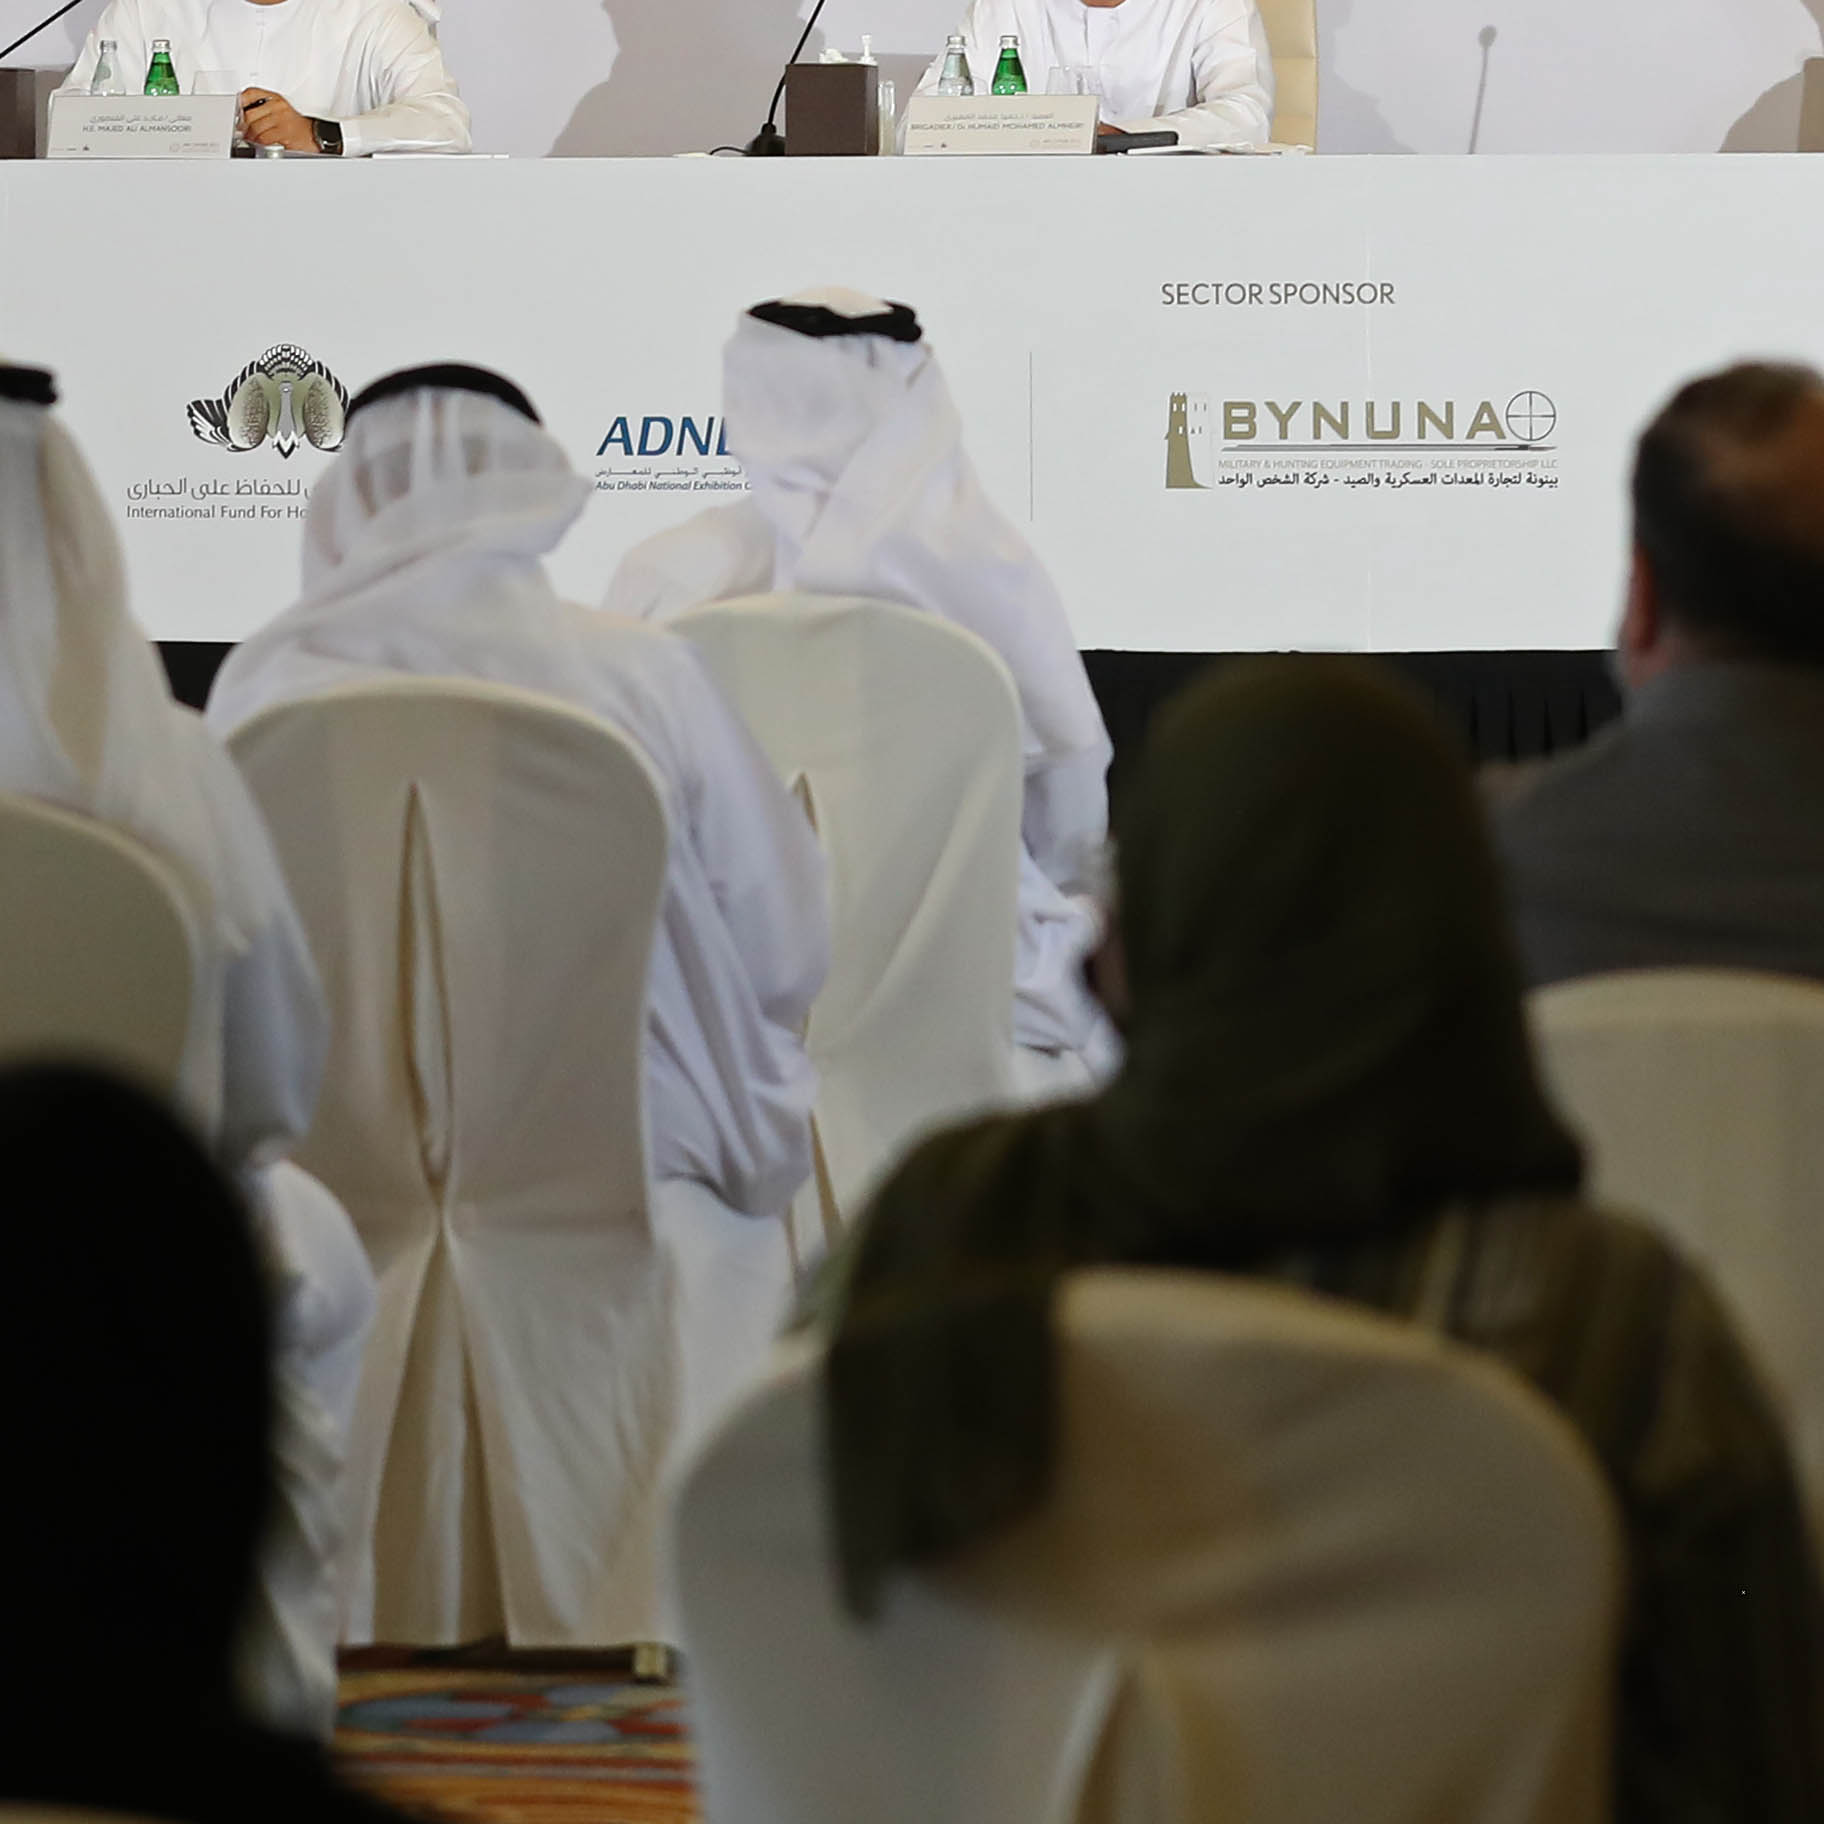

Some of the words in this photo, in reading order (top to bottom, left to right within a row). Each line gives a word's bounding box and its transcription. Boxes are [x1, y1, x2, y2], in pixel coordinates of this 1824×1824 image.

[1161, 282, 1264, 306] SECTOR
[1269, 282, 1395, 305] SPONSOR
[1222, 400, 1509, 441] BYNUNA
[595, 415, 733, 457] ADN
[1219, 460, 1262, 469] MILITARY
[1264, 460, 1271, 468] &
[1273, 460, 1318, 468] HUNTING
[1320, 460, 1378, 469] EQUIPMENT
[1378, 459, 1422, 469] TRADING
[1431, 460, 1455, 469] SOLE
[1541, 459, 1557, 468] LLC
[234, 478, 301, 496] للحفاظ
[595, 481, 615, 490] Abu
[617, 481, 646, 490] Dhabi
[649, 481, 692, 490] National
[693, 481, 742, 490] Exhibition
[1218, 472, 1253, 489] الواحد
[1256, 472, 1300, 489] الشخص
[1303, 471, 1330, 489] شركة
[1343, 472, 1381, 489] والصيد
[1384, 471, 1437, 489] العسكرية
[1442, 473, 1483, 485] المعدات
[1487, 472, 1522, 488] لتجارة
[1525, 471, 1559, 489] بينونة
[126, 477, 187, 501] الحبارى
[190, 478, 231, 501] على
[128, 505, 215, 518] International
[221, 505, 255, 518] Fund
[261, 506, 282, 518] For
